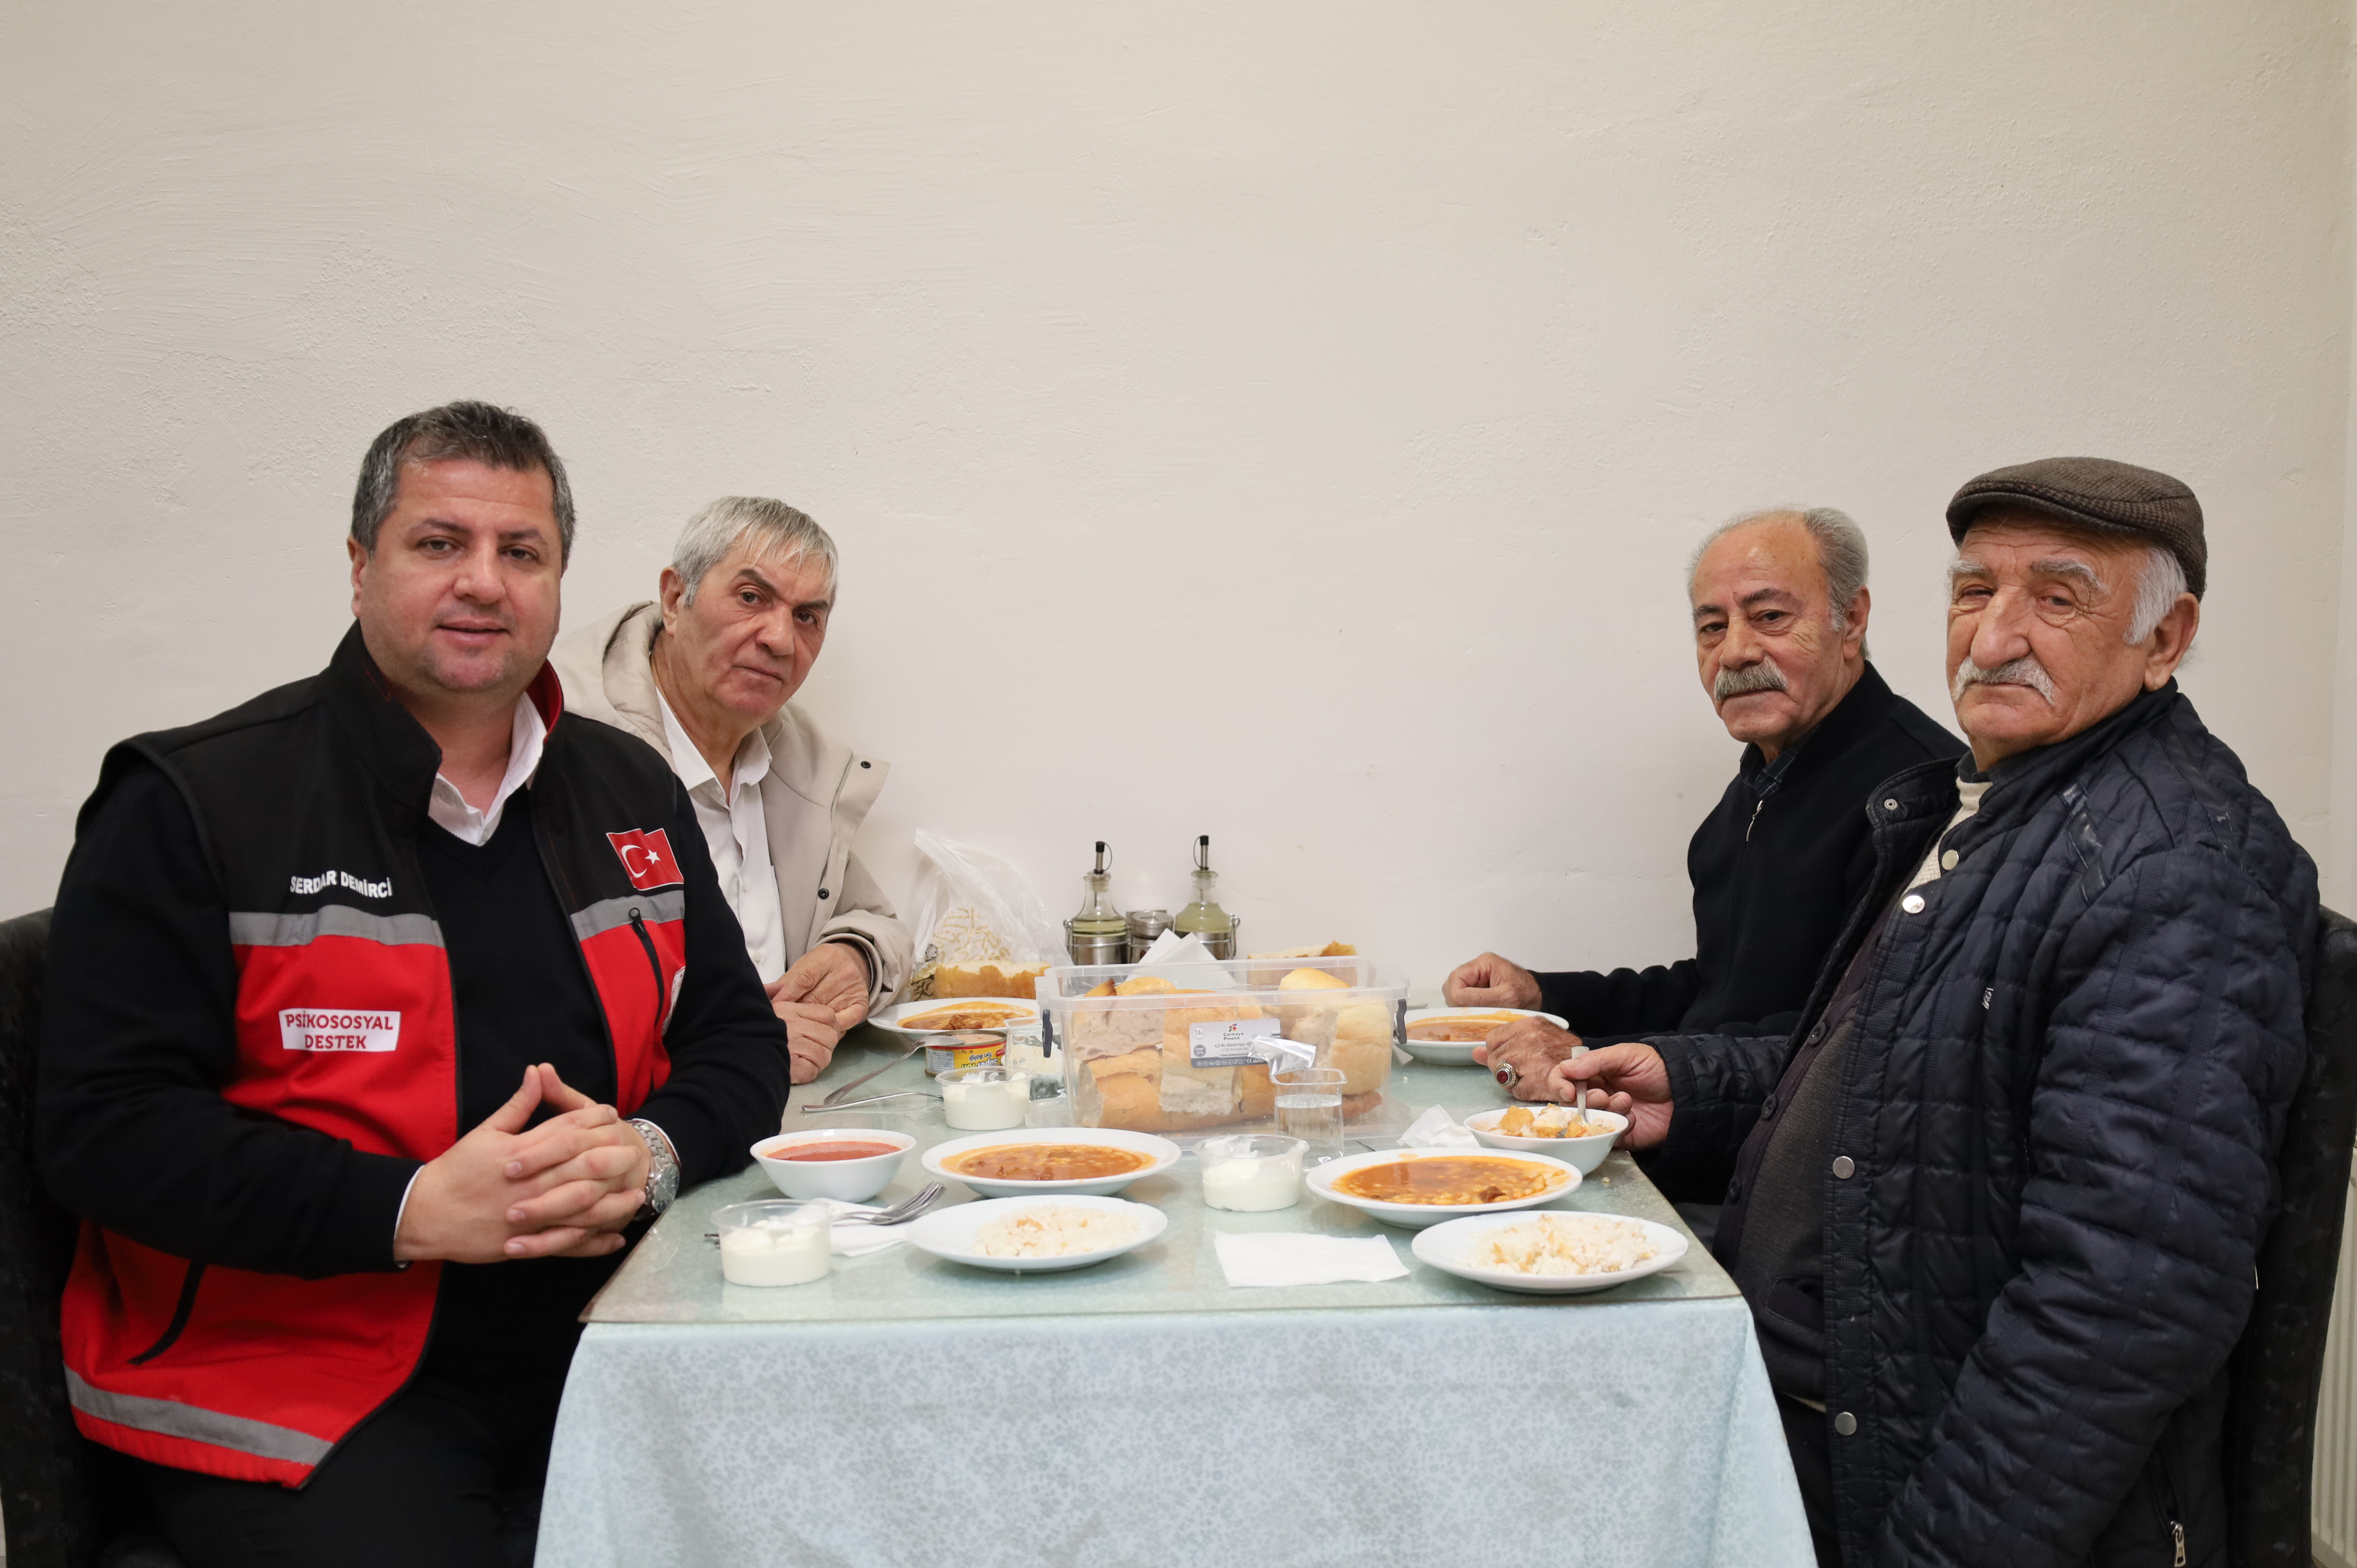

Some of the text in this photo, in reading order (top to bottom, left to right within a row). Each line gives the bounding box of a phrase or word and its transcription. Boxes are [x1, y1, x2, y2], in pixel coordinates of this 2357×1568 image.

[290, 870, 393, 898] SERDAR DEMİRCİ
[284, 1010, 393, 1030] PSİKOSOSYAL
[304, 1034, 367, 1049] DESTEK
[968, 1054, 983, 1062] Balığı
